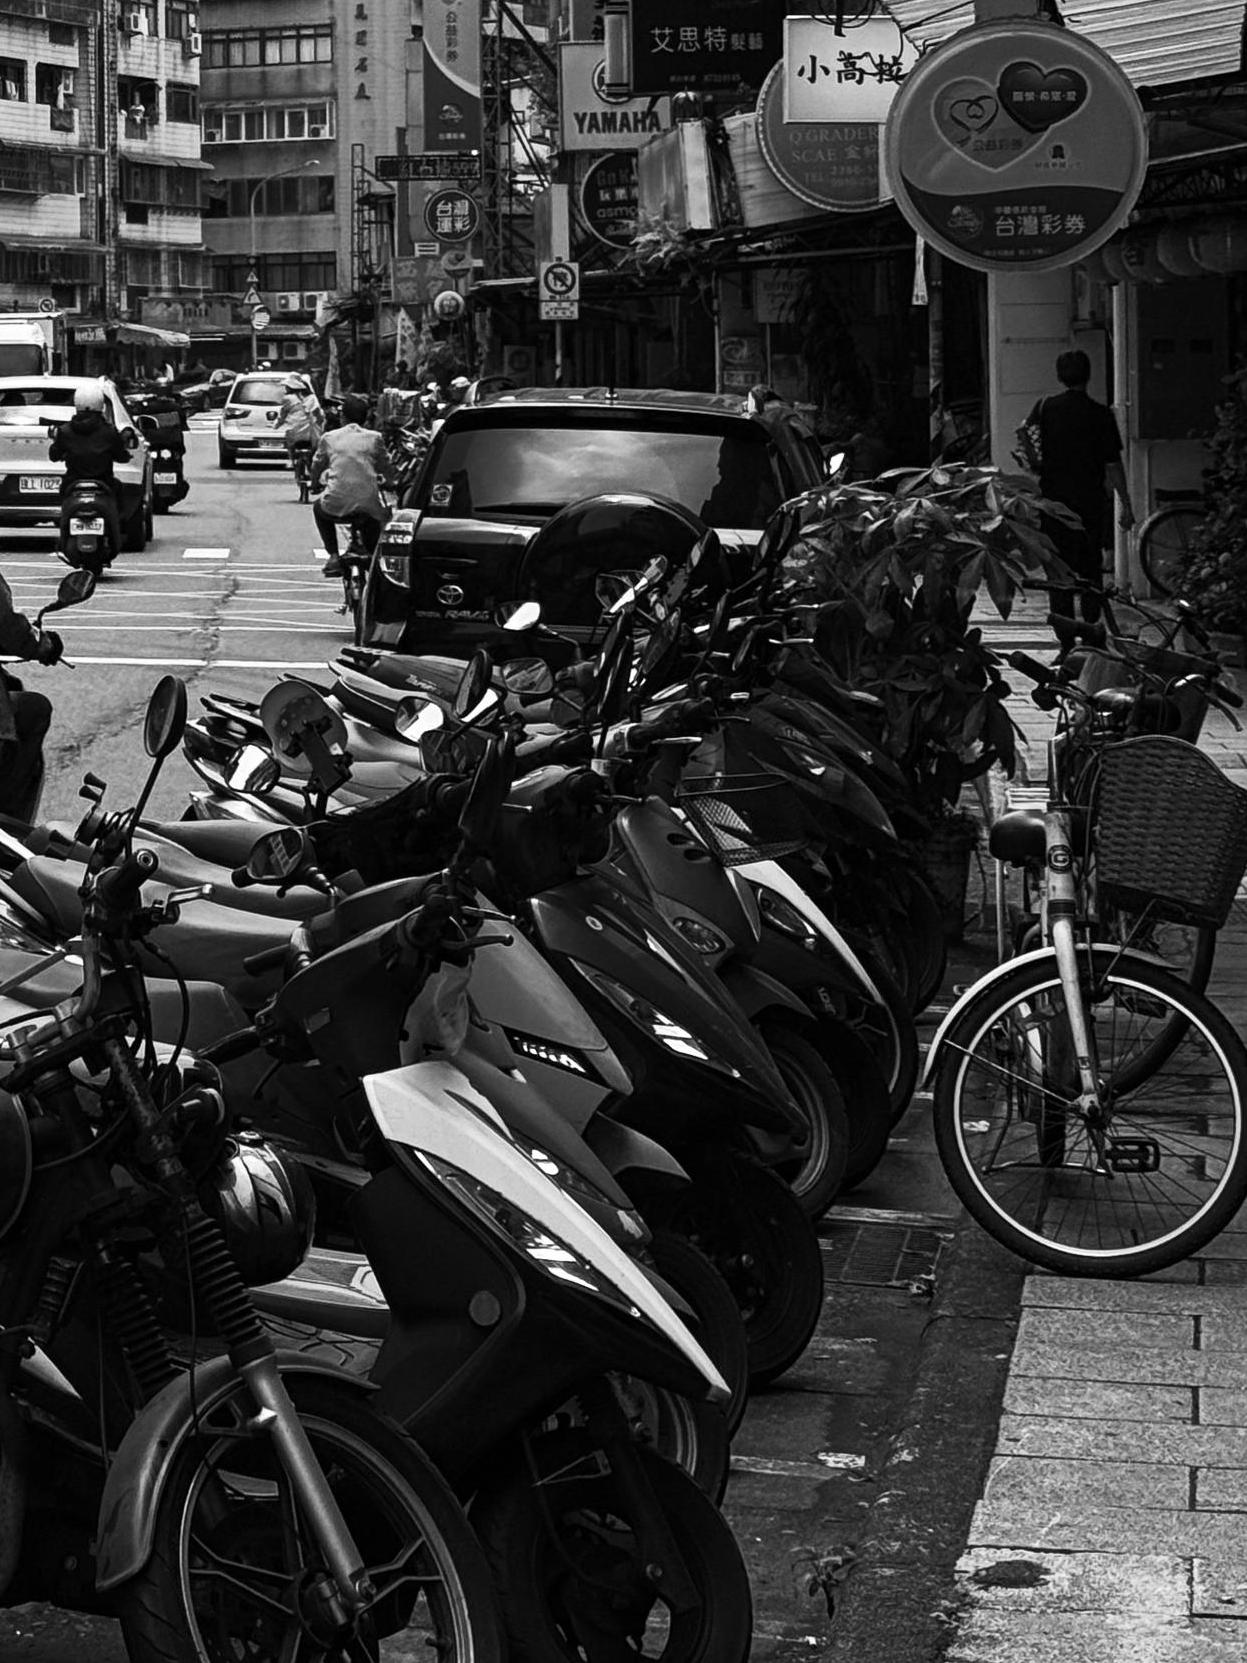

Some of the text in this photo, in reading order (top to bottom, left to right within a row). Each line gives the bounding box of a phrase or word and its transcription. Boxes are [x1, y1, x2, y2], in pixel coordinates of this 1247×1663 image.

[573, 111, 662, 134] YAMAHA
[995, 213, 1087, 237] 台灣彩券
